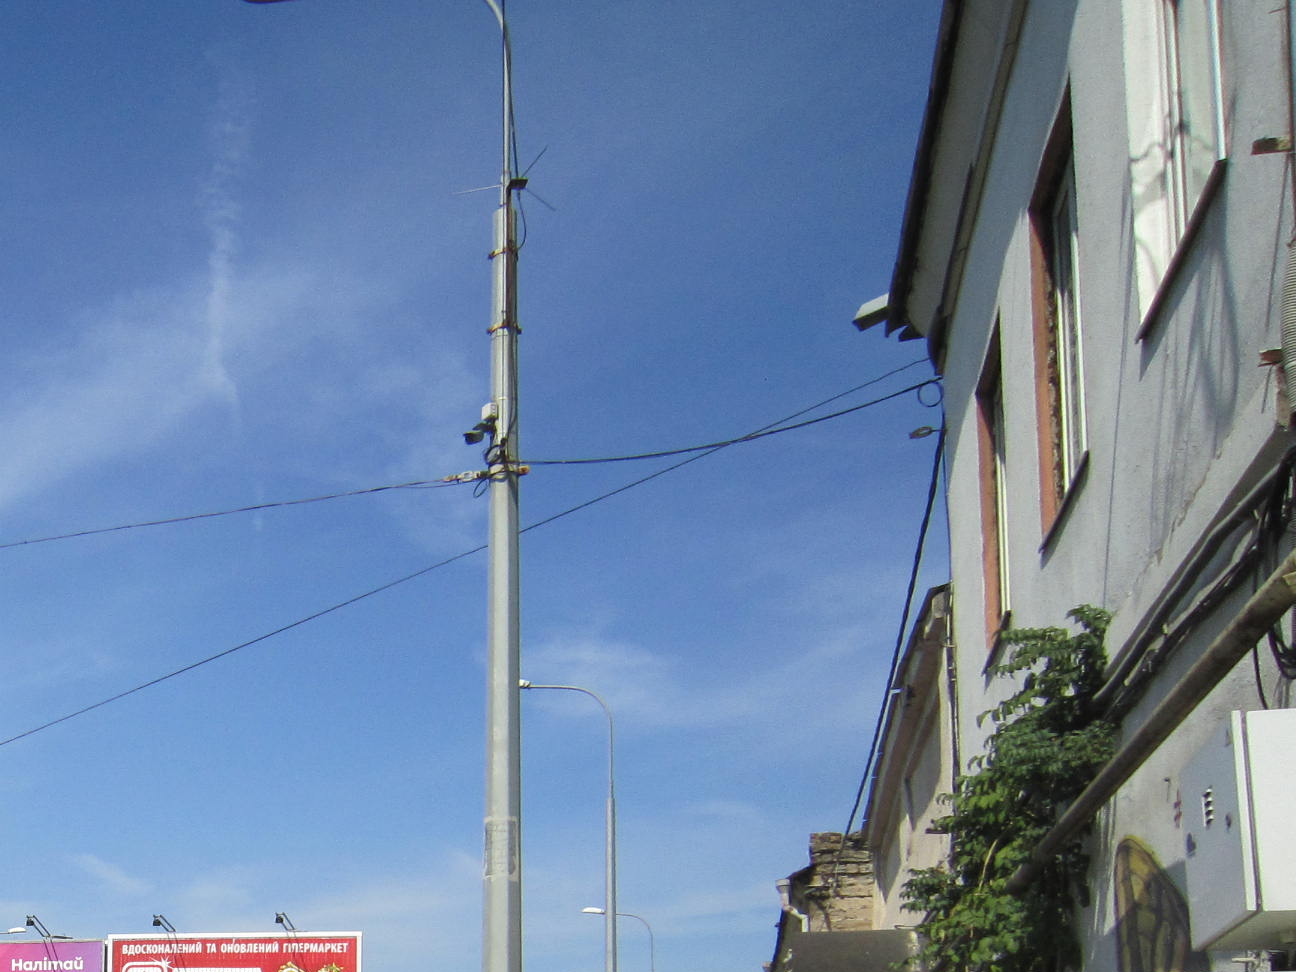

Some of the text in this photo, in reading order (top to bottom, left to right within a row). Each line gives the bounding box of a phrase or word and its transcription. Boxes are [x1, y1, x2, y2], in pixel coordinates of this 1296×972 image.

[122, 941, 349, 956] ВДОСКОНАЛЕНИЙ ТА ОНОВЛЕНИЙ ГІПЕРМАРКЕТ
[11, 957, 84, 972] Налітай
